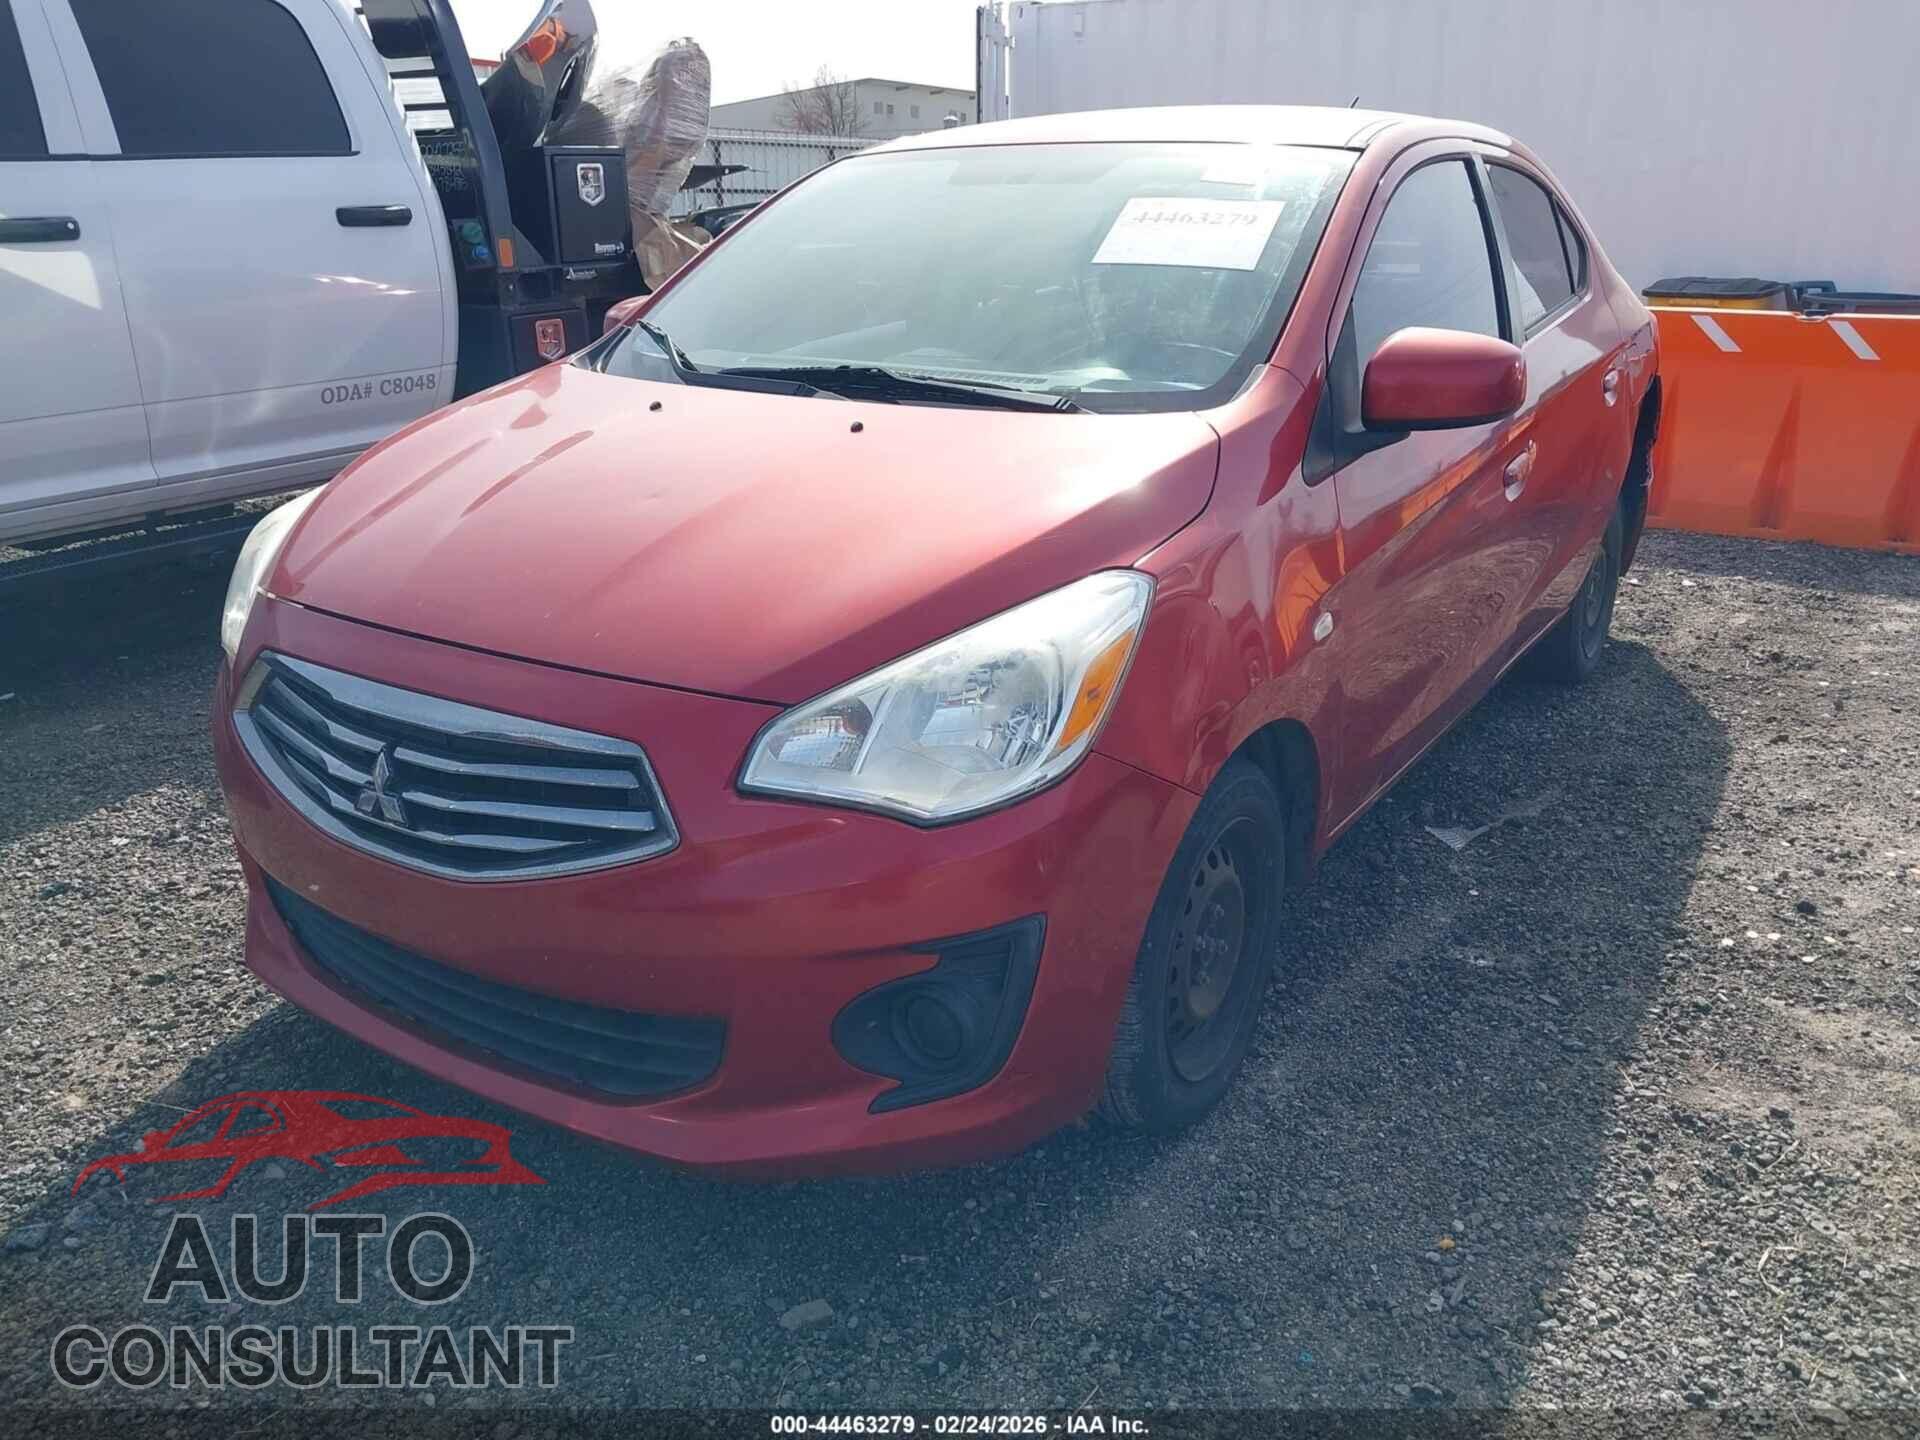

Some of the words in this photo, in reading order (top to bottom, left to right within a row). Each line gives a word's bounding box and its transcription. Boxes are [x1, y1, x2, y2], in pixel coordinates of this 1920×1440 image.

[1132, 210, 1260, 226] 44463279
[320, 381, 373, 405] ODA#
[380, 373, 437, 397] C8048
